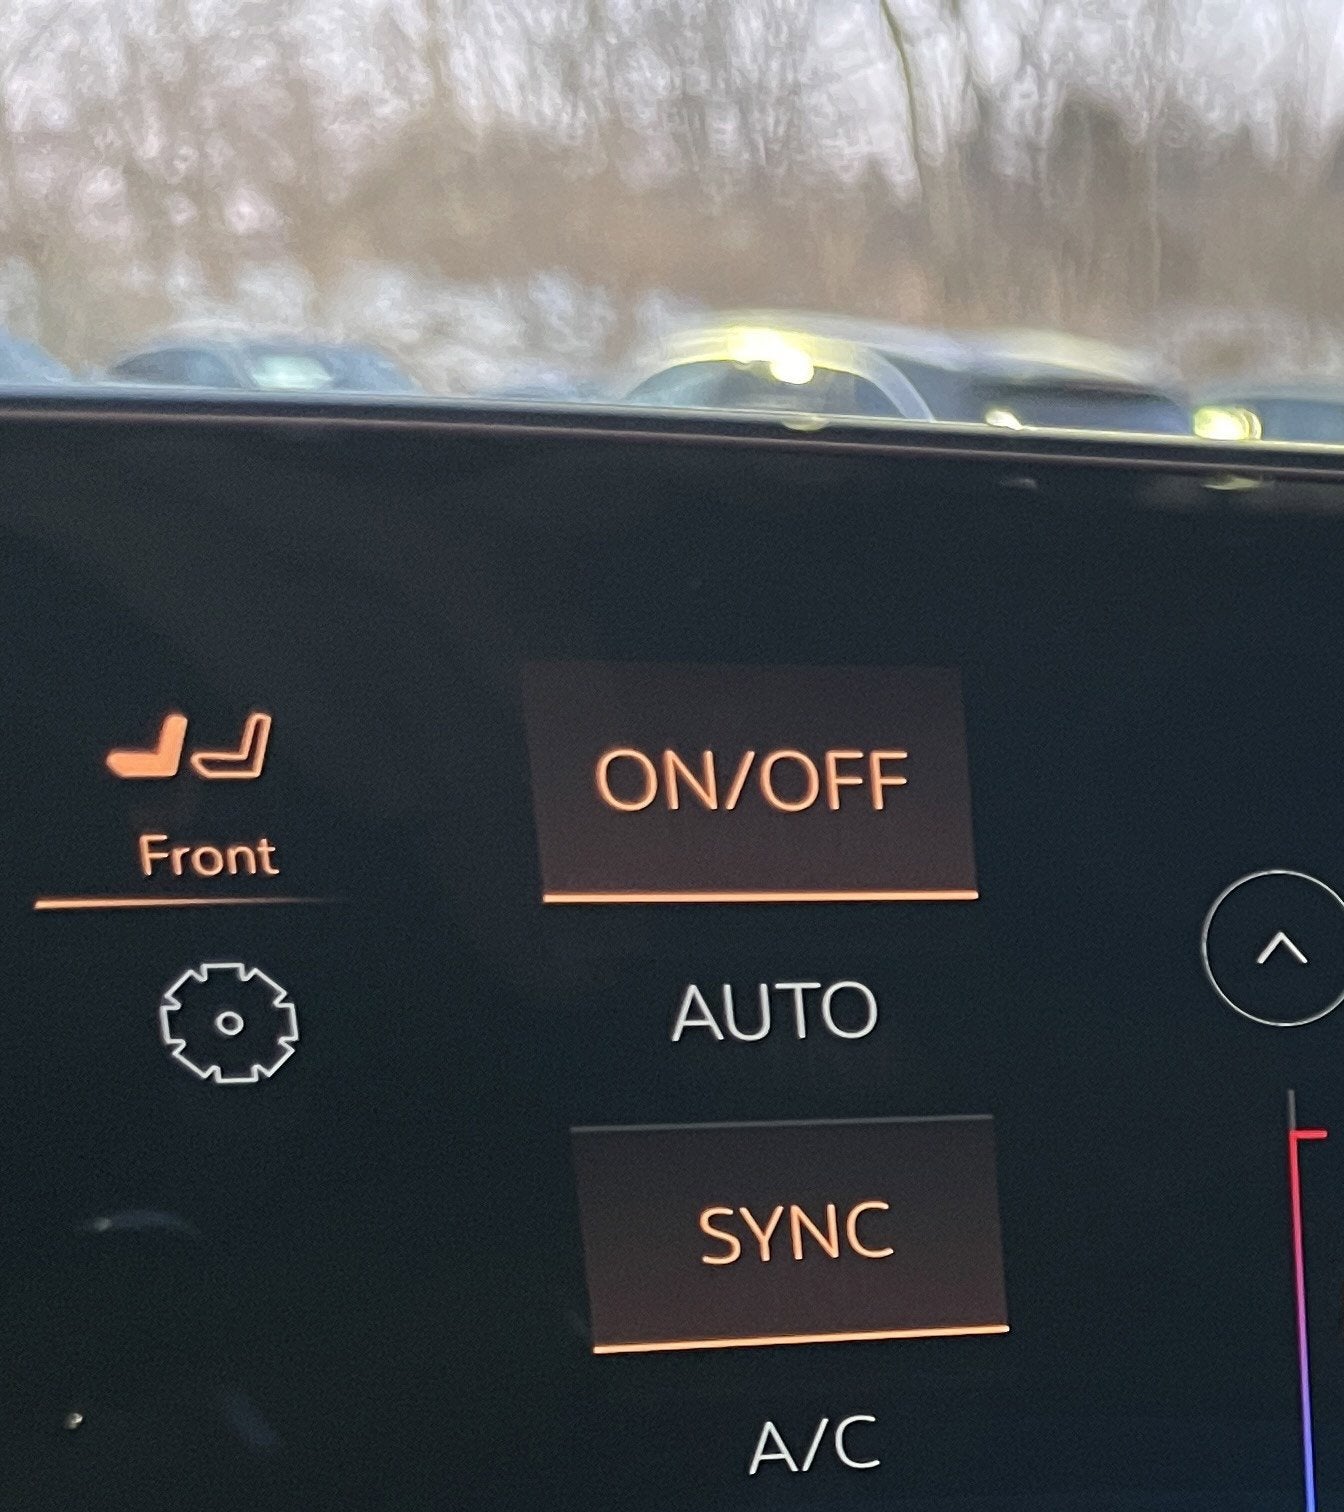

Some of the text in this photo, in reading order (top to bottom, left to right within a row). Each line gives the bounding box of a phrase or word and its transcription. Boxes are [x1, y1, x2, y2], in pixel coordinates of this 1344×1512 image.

[594, 747, 909, 813] ON/OFF
[138, 833, 281, 876] Front
[671, 980, 879, 1043] AUTO
[698, 1199, 895, 1266] SYNC
[748, 1412, 882, 1476] A/C
